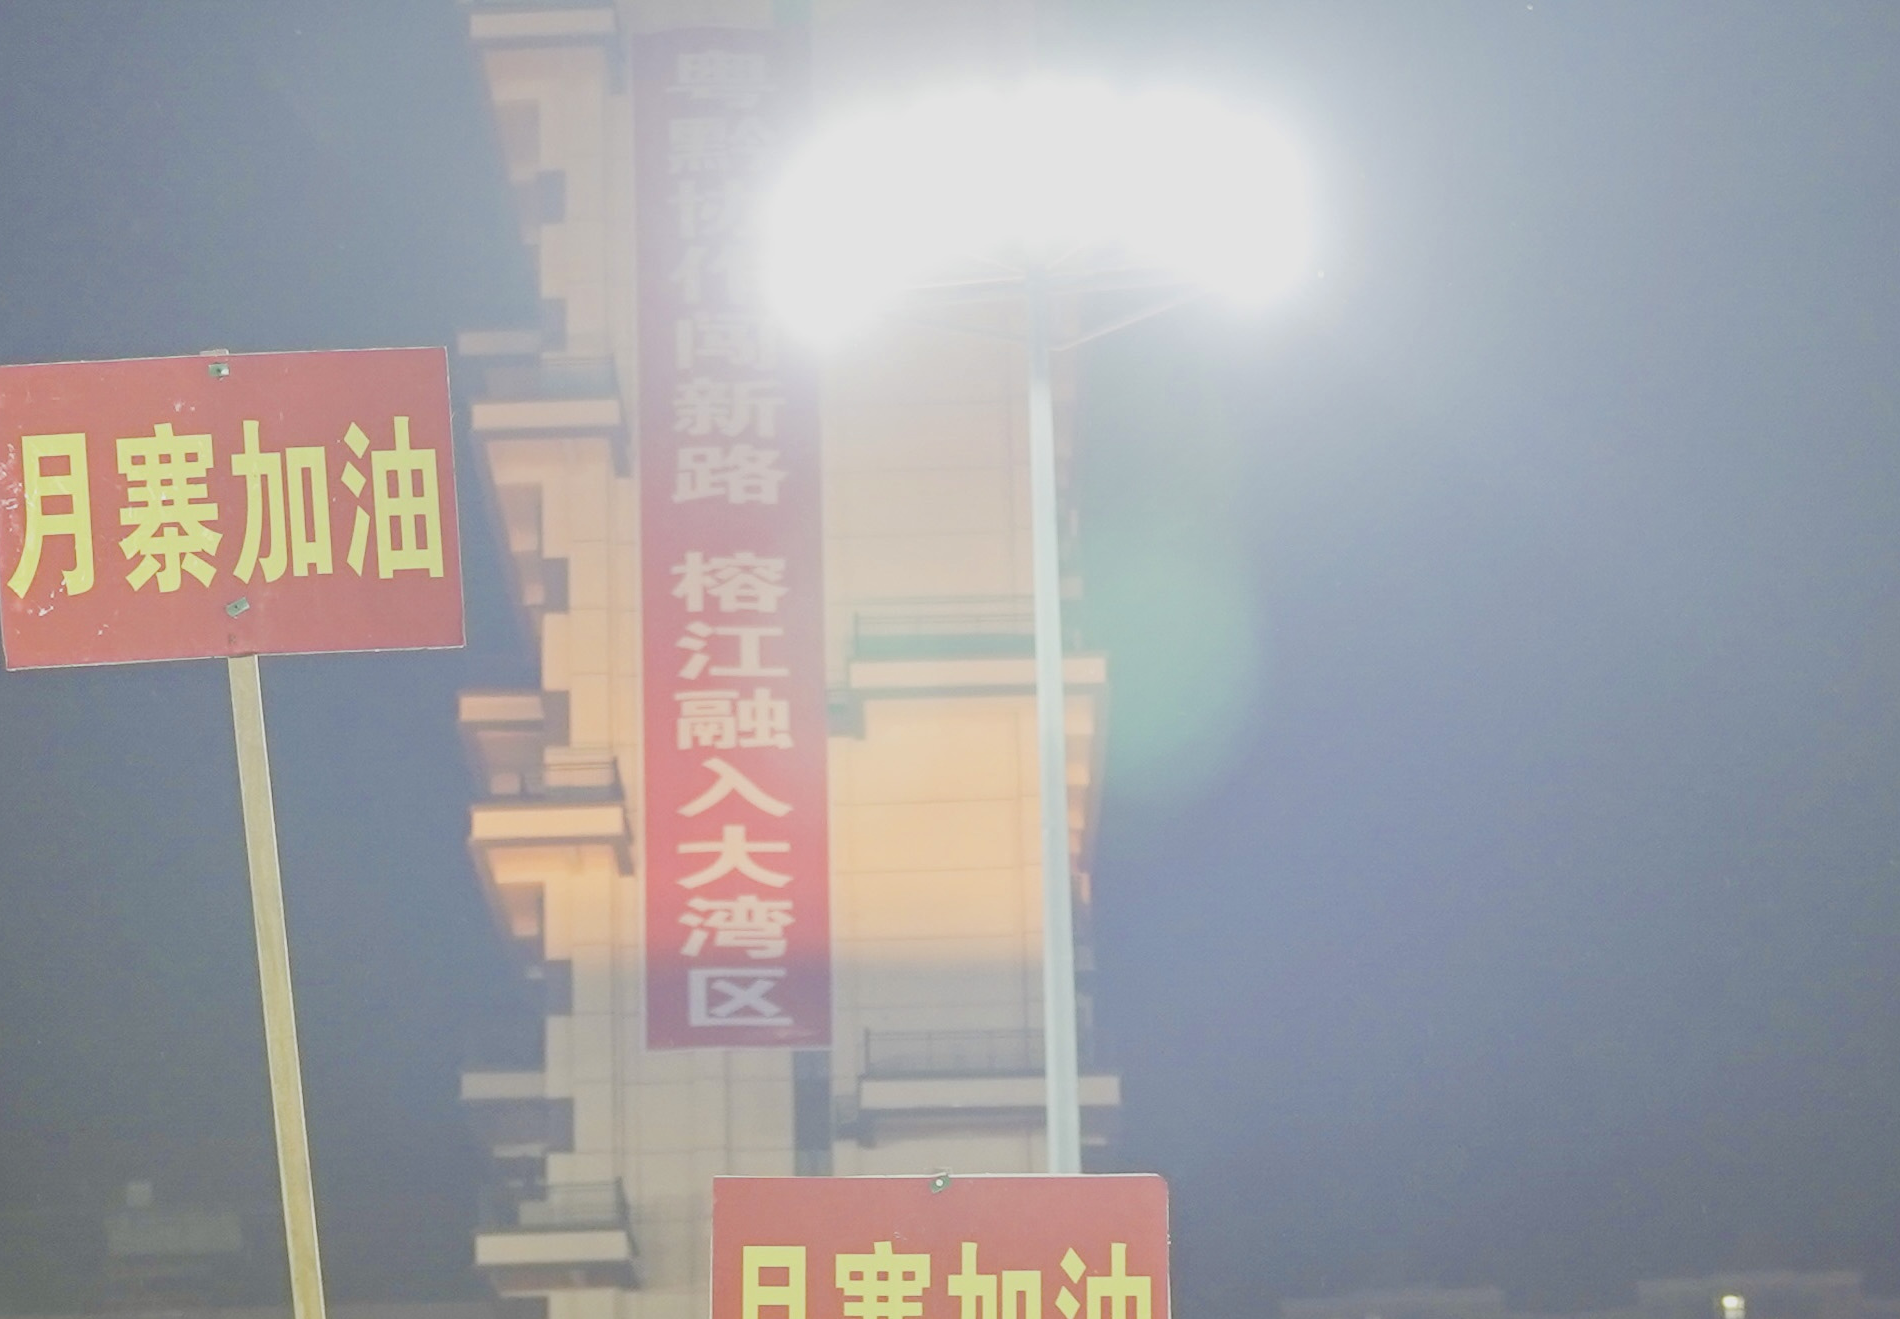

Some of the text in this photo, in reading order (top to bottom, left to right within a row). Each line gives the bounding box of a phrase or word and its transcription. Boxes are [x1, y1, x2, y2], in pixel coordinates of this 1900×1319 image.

[7, 416, 444, 599] 月寨加油
[671, 550, 795, 1028] 榕江融入大湾区
